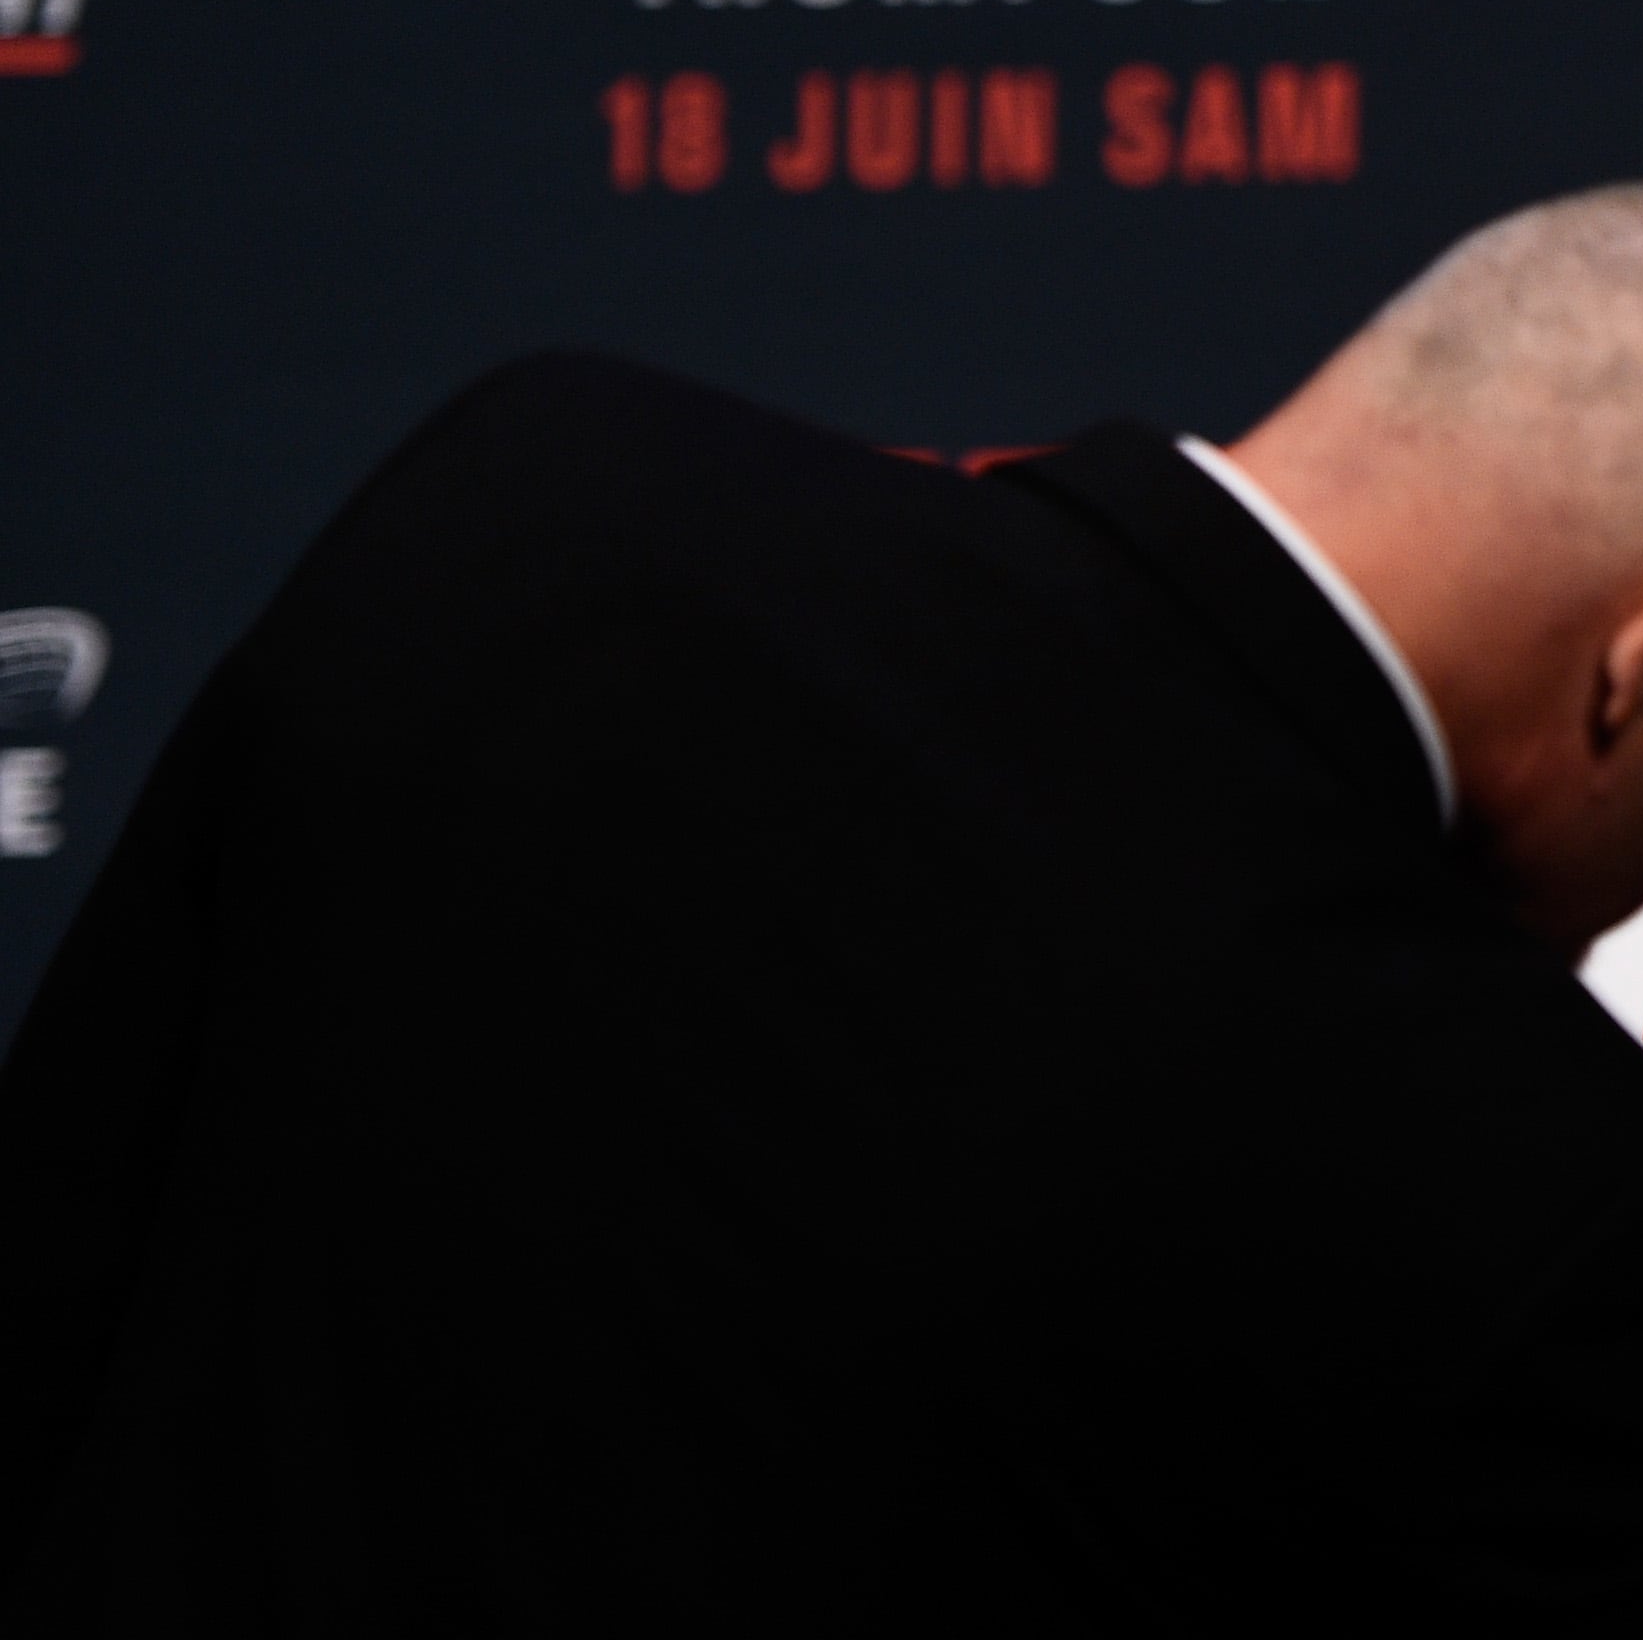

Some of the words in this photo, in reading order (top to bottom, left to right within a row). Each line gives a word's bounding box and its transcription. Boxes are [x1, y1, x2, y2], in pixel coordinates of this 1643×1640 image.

[602, 71, 728, 193] 18
[768, 68, 1056, 192] JUIN
[1102, 62, 1361, 187] SAM
